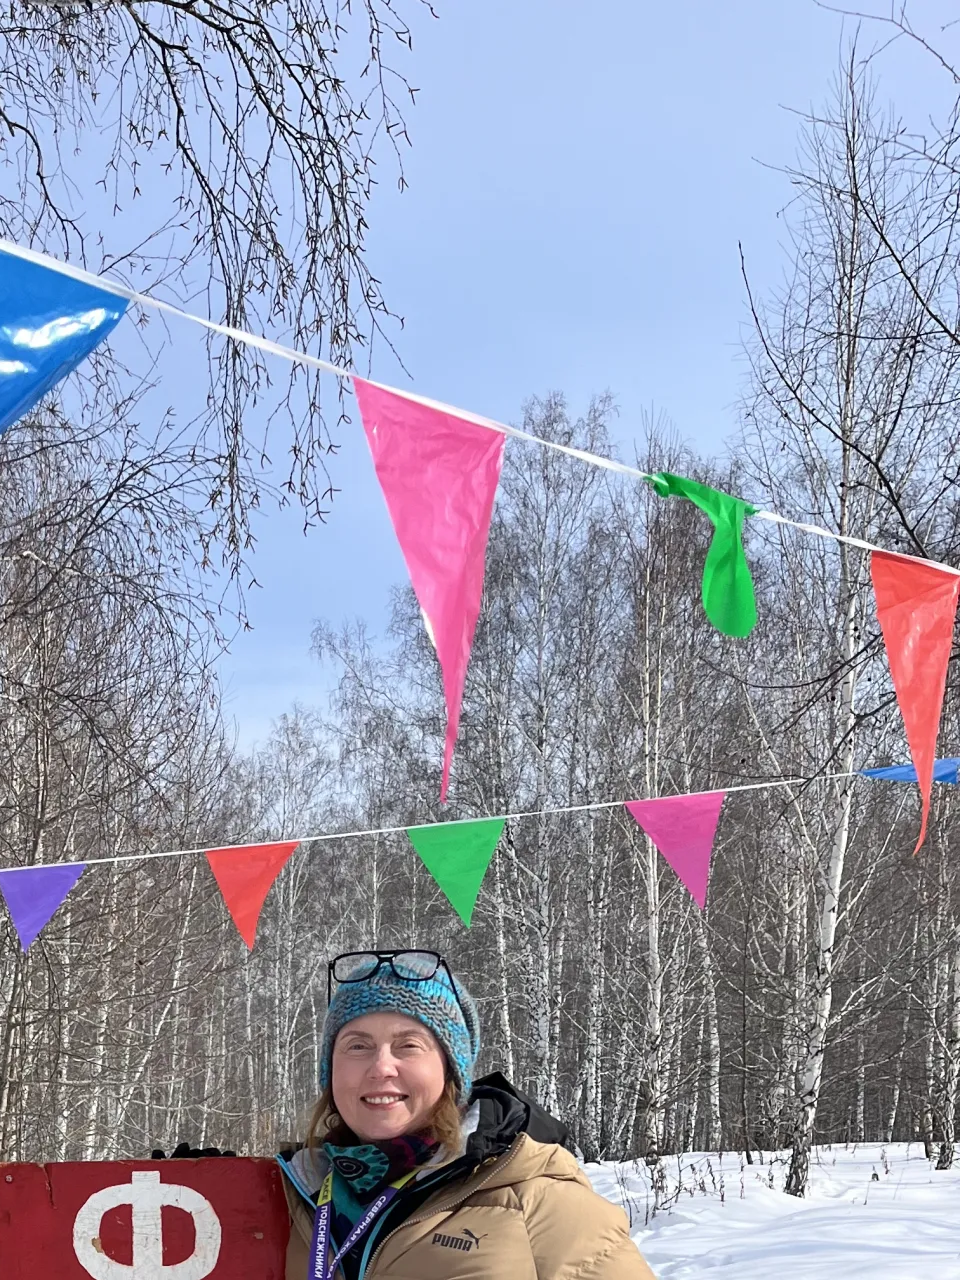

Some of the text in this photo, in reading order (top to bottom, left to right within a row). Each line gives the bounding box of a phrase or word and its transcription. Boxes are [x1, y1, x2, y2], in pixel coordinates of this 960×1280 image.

[314, 1205, 329, 1279] ПОДСНЕЖНИКИ
[349, 1195, 387, 1242] СЕВЕРНАЯ
[431, 1232, 474, 1252] PUMA
